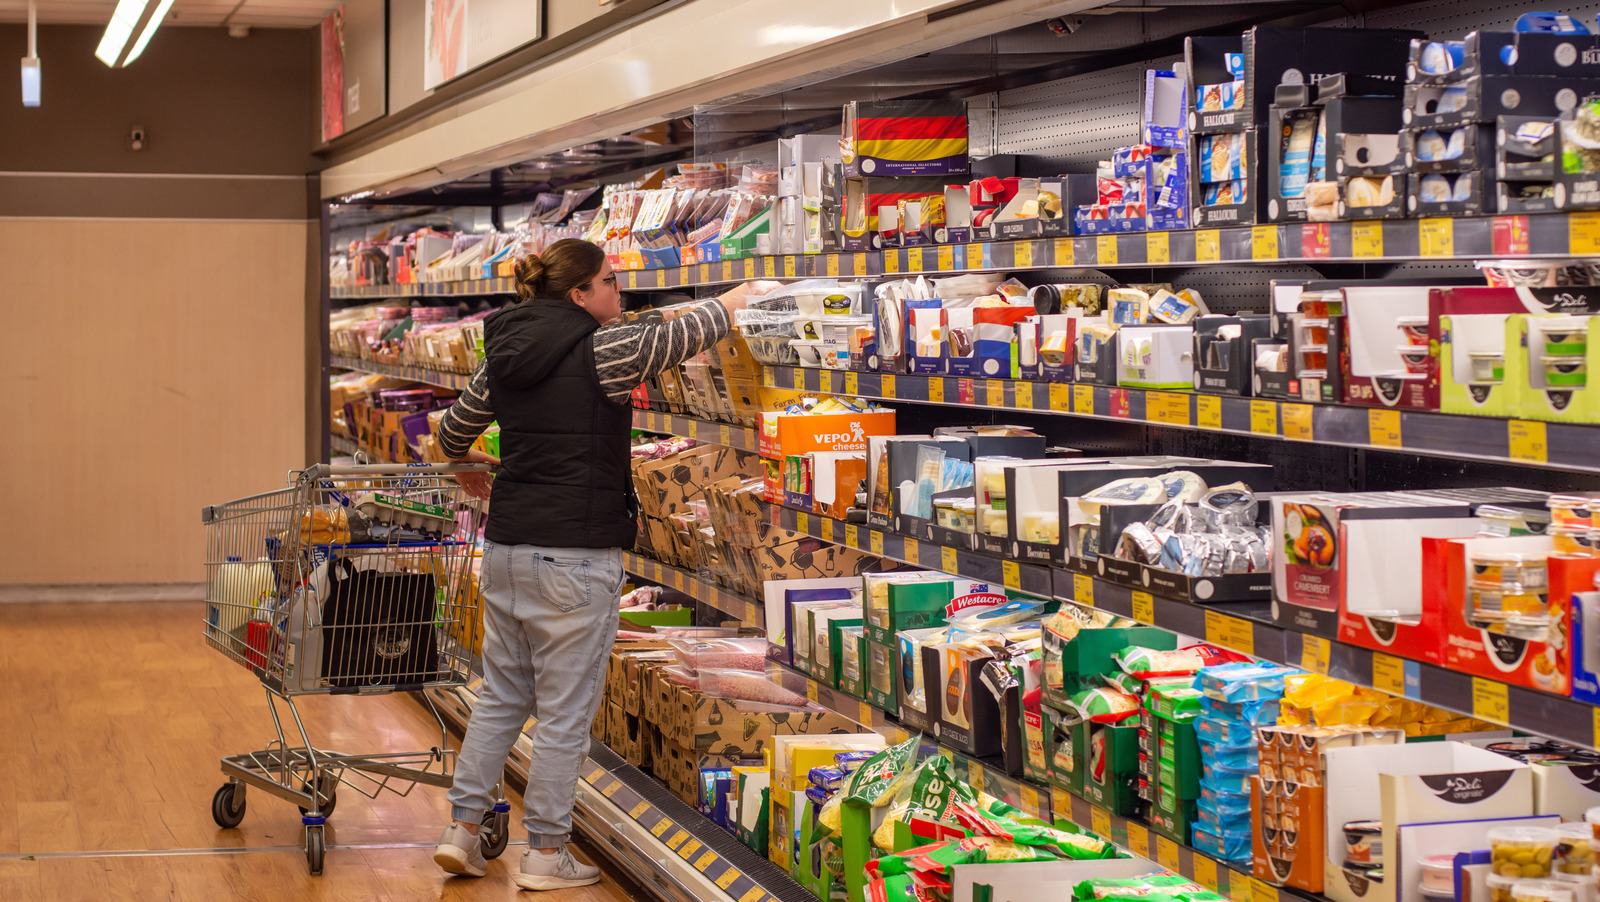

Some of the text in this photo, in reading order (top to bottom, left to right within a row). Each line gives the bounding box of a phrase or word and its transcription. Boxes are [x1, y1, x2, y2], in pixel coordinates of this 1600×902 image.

[1203, 113, 1235, 127] HALLOUMI
[1208, 209, 1238, 221] HALLOUMI
[772, 398, 796, 410] Farm
[813, 433, 851, 444] VEPO
[832, 442, 866, 451] cheese
[1293, 581, 1331, 595] CAMEMBERT
[956, 595, 1002, 609] Westacre
[1454, 777, 1483, 791] Deli
